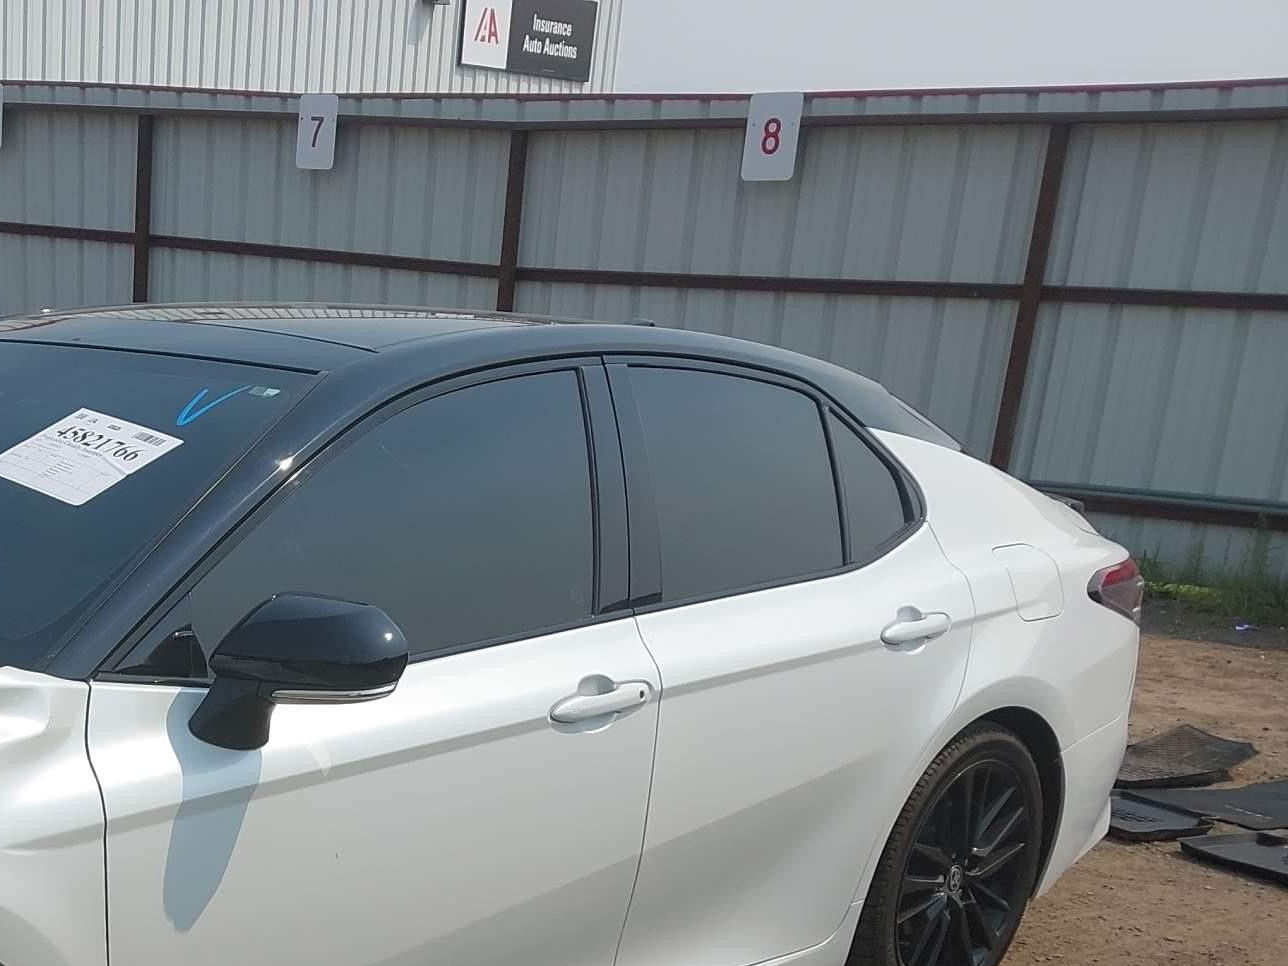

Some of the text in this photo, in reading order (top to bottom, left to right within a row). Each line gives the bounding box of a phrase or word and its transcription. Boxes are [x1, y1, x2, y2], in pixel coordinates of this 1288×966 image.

[533, 14, 573, 37] Insurance
[522, 34, 578, 59] Auto Auctions
[310, 116, 325, 148] 7
[761, 117, 782, 155] 8
[57, 425, 147, 462] 45821766
